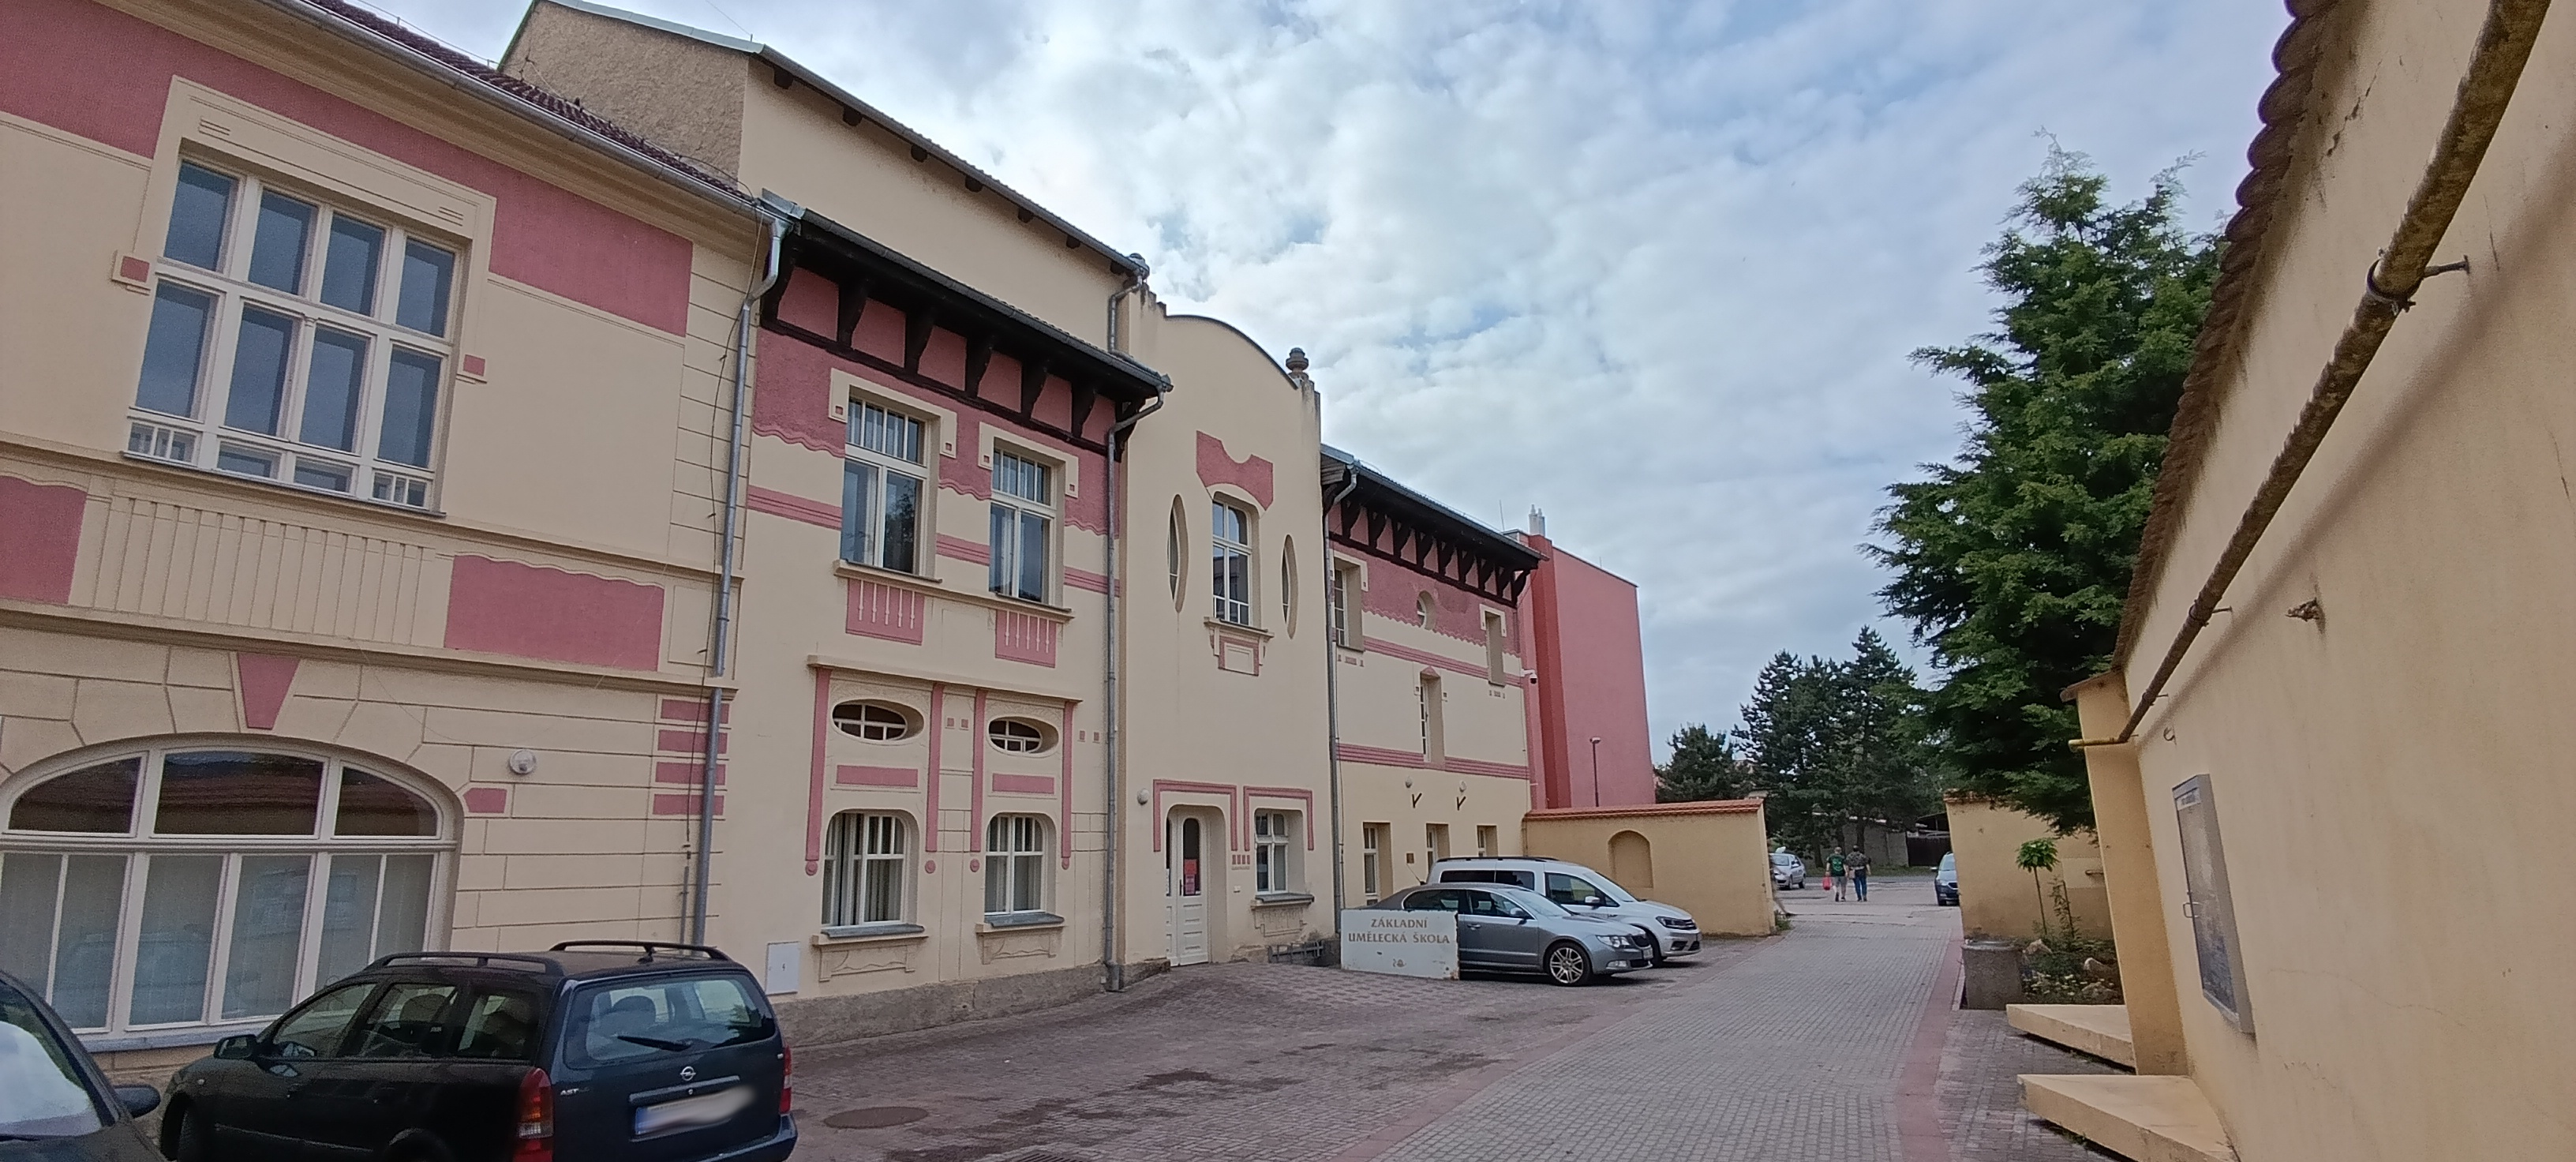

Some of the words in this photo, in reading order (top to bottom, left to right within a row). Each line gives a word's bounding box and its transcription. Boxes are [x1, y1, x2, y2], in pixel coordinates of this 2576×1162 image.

[1371, 916, 1428, 928] ZÁKLADNÍ
[1348, 931, 1407, 943] UMĚLECKÁ
[1413, 931, 1450, 944] ŠKOLA
